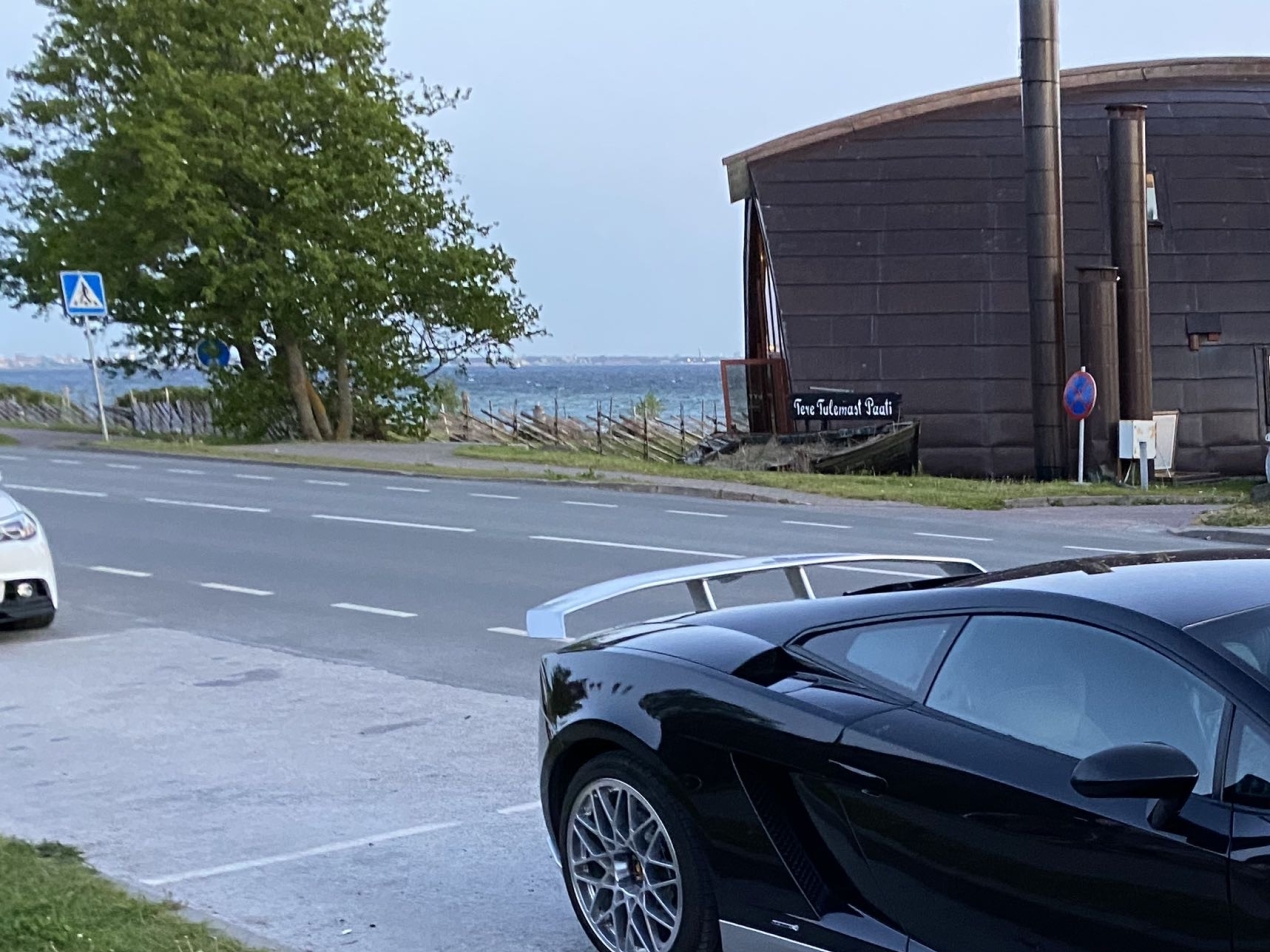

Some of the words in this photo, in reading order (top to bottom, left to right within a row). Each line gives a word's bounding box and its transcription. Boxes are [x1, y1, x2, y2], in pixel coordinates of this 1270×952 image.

[794, 398, 815, 416] Tere
[816, 398, 862, 416] Tulemast
[864, 397, 893, 416] Paati
